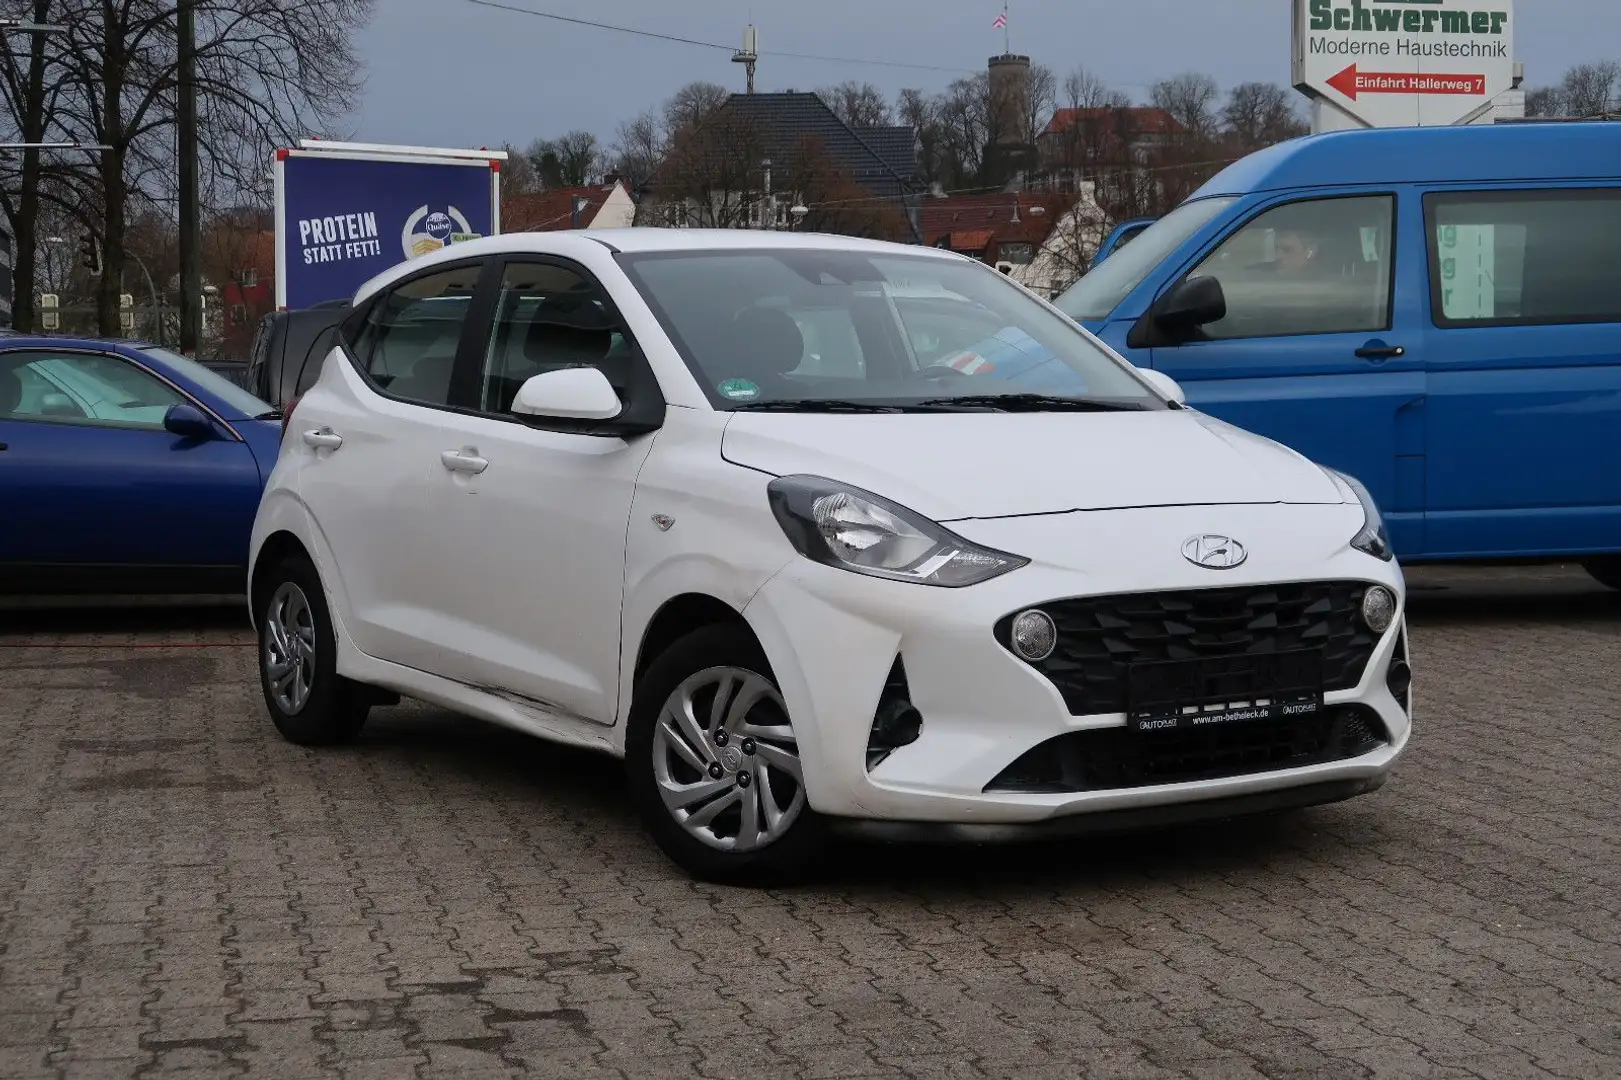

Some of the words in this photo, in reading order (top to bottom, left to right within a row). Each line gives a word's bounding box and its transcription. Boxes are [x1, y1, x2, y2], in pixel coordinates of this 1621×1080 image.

[1310, 0, 1507, 34] Schwermer
[1310, 37, 1390, 55] Moderne
[1397, 38, 1507, 57] Haustechnik
[1355, 76, 1406, 89] Einfahrt
[1409, 78, 1472, 92] Hallerweg
[1475, 79, 1483, 90] 7
[299, 211, 378, 245] PROTEIN
[303, 244, 342, 264] STATT
[345, 240, 380, 258] FETT!
